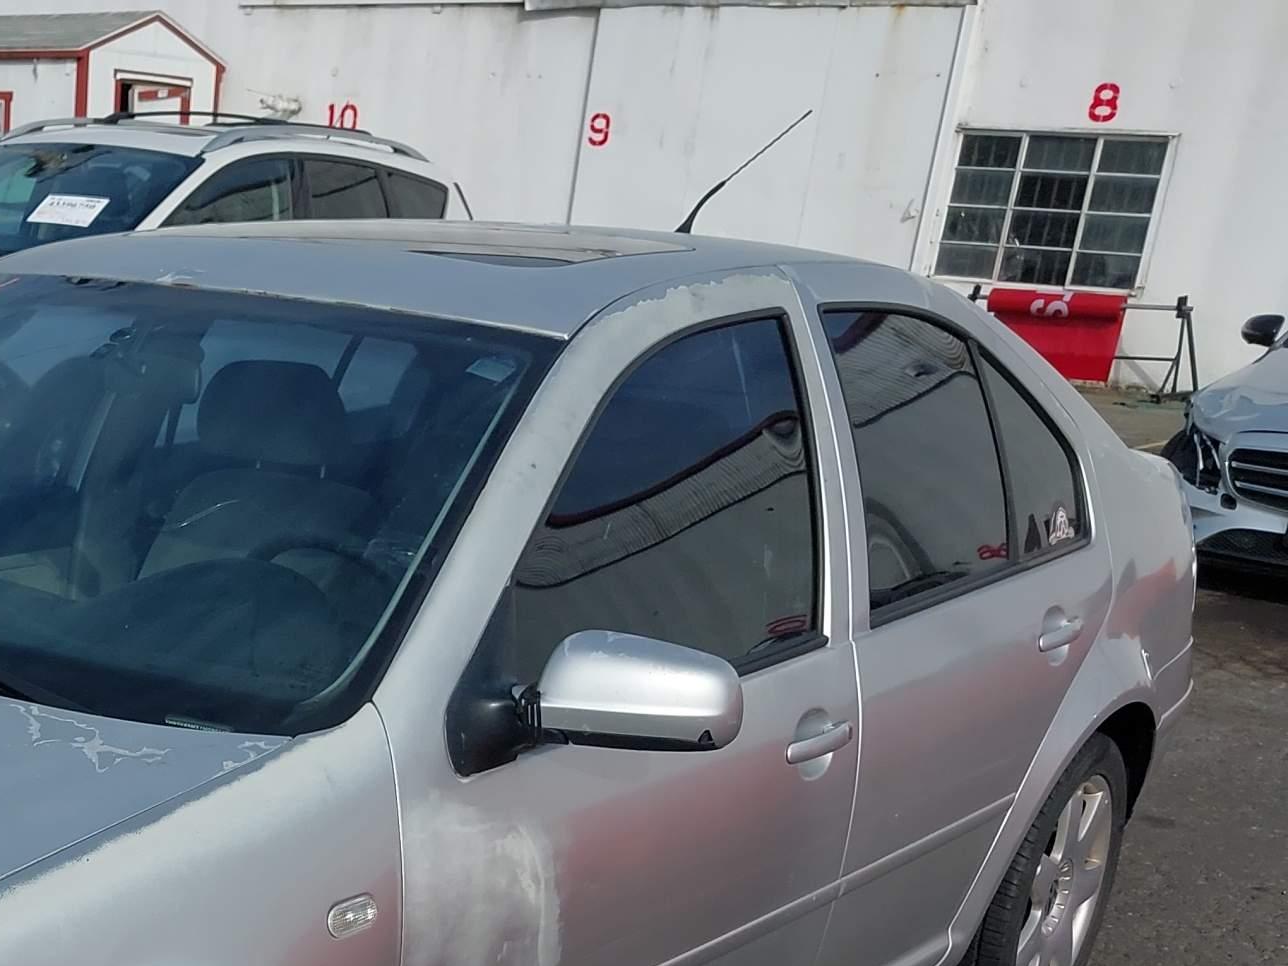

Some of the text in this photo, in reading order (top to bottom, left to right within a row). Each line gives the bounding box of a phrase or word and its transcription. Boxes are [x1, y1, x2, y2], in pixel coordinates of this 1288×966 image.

[328, 103, 357, 128] 10
[1088, 83, 1120, 122] 8
[588, 113, 610, 146] 9
